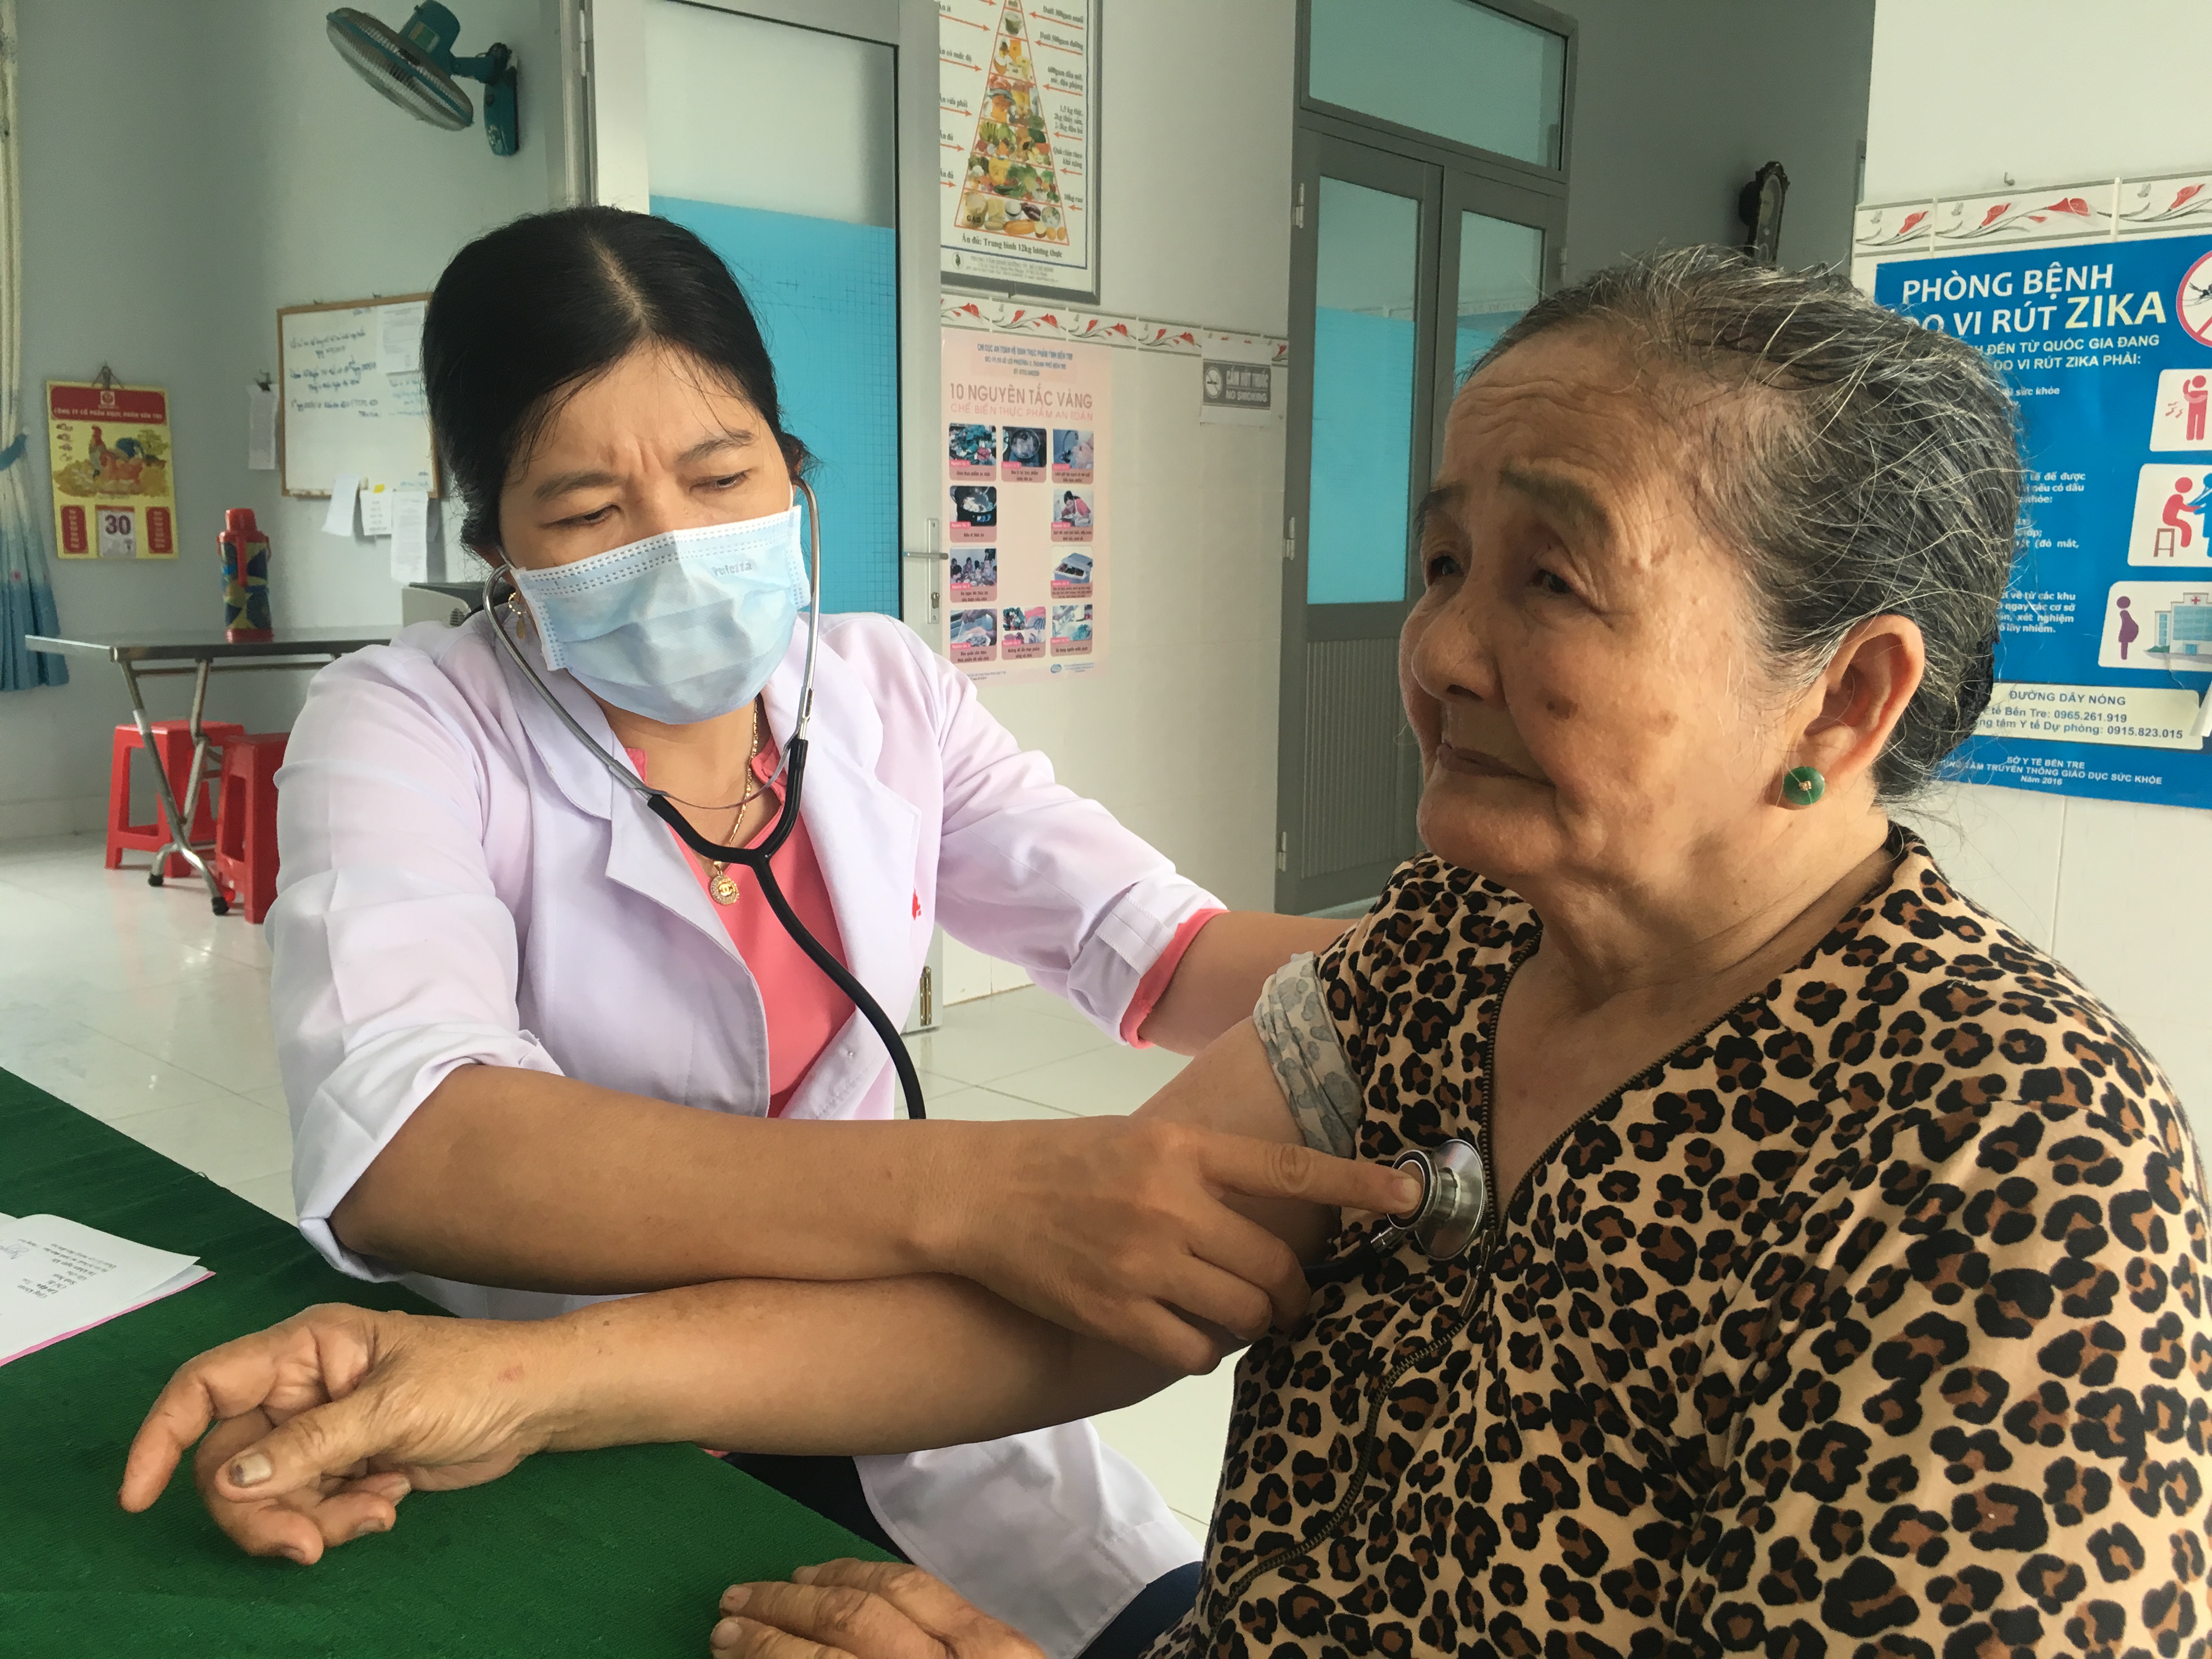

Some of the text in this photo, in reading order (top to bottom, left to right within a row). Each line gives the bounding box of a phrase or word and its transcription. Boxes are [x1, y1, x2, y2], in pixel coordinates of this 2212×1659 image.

[983, 238, 1002, 250] Trung
[1003, 241, 1017, 251] bình
[1018, 244, 1031, 254] 12kg
[1902, 261, 2113, 304] PHÒNG BỆNH
[1953, 311, 1982, 336] VI
[1991, 301, 2057, 334] RÚT
[2064, 291, 2166, 330] ZIKA
[1987, 341, 2015, 355] ĐẾN
[2019, 339, 2040, 353] TỪ
[2043, 336, 2084, 352] QUỐC
[2089, 337, 2113, 349] GIA
[2118, 334, 2160, 348] ĐANG
[2017, 358, 2030, 370] VI
[2034, 355, 2062, 369] RÚT
[2066, 355, 2099, 368] ZIKA
[2103, 351, 2141, 366] PHẢI:
[950, 383, 1093, 409] 10 NGUYÊN TẮC VÀNG
[951, 402, 970, 414] CHẾ
[974, 402, 996, 415] BIẾN
[1000, 406, 1024, 417] THỰC
[1026, 405, 1053, 419] PHẨM
[1055, 410, 1068, 420] AN
[105, 514, 131, 535] 30
[2057, 591, 2076, 601] khu
[2009, 690, 2126, 706] ĐƯỜNG DÂY NÓNG
[2005, 706, 2026, 717] Bến
[2031, 708, 2051, 718] Tre:
[2054, 709, 2128, 723] 0965.261.919
[2019, 720, 2027, 729] Y
[2030, 718, 2040, 730] tế
[2043, 721, 2061, 732] Dự
[2063, 723, 2103, 736] phòng:
[2107, 726, 2183, 740] 0915.823.015
[2023, 757, 2029, 765] Y
[2031, 757, 2042, 766] TẾ
[2045, 758, 2064, 768] BẾN
[2066, 760, 2085, 769] TRE
[2020, 775, 2063, 786] Năm 2016
[2026, 766, 2059, 777] THÔNG
[2061, 769, 2085, 778] GIÁO
[2087, 771, 2108, 781] DỤC
[2111, 771, 2132, 782] SỨC
[2134, 775, 2163, 785] KHỎE
